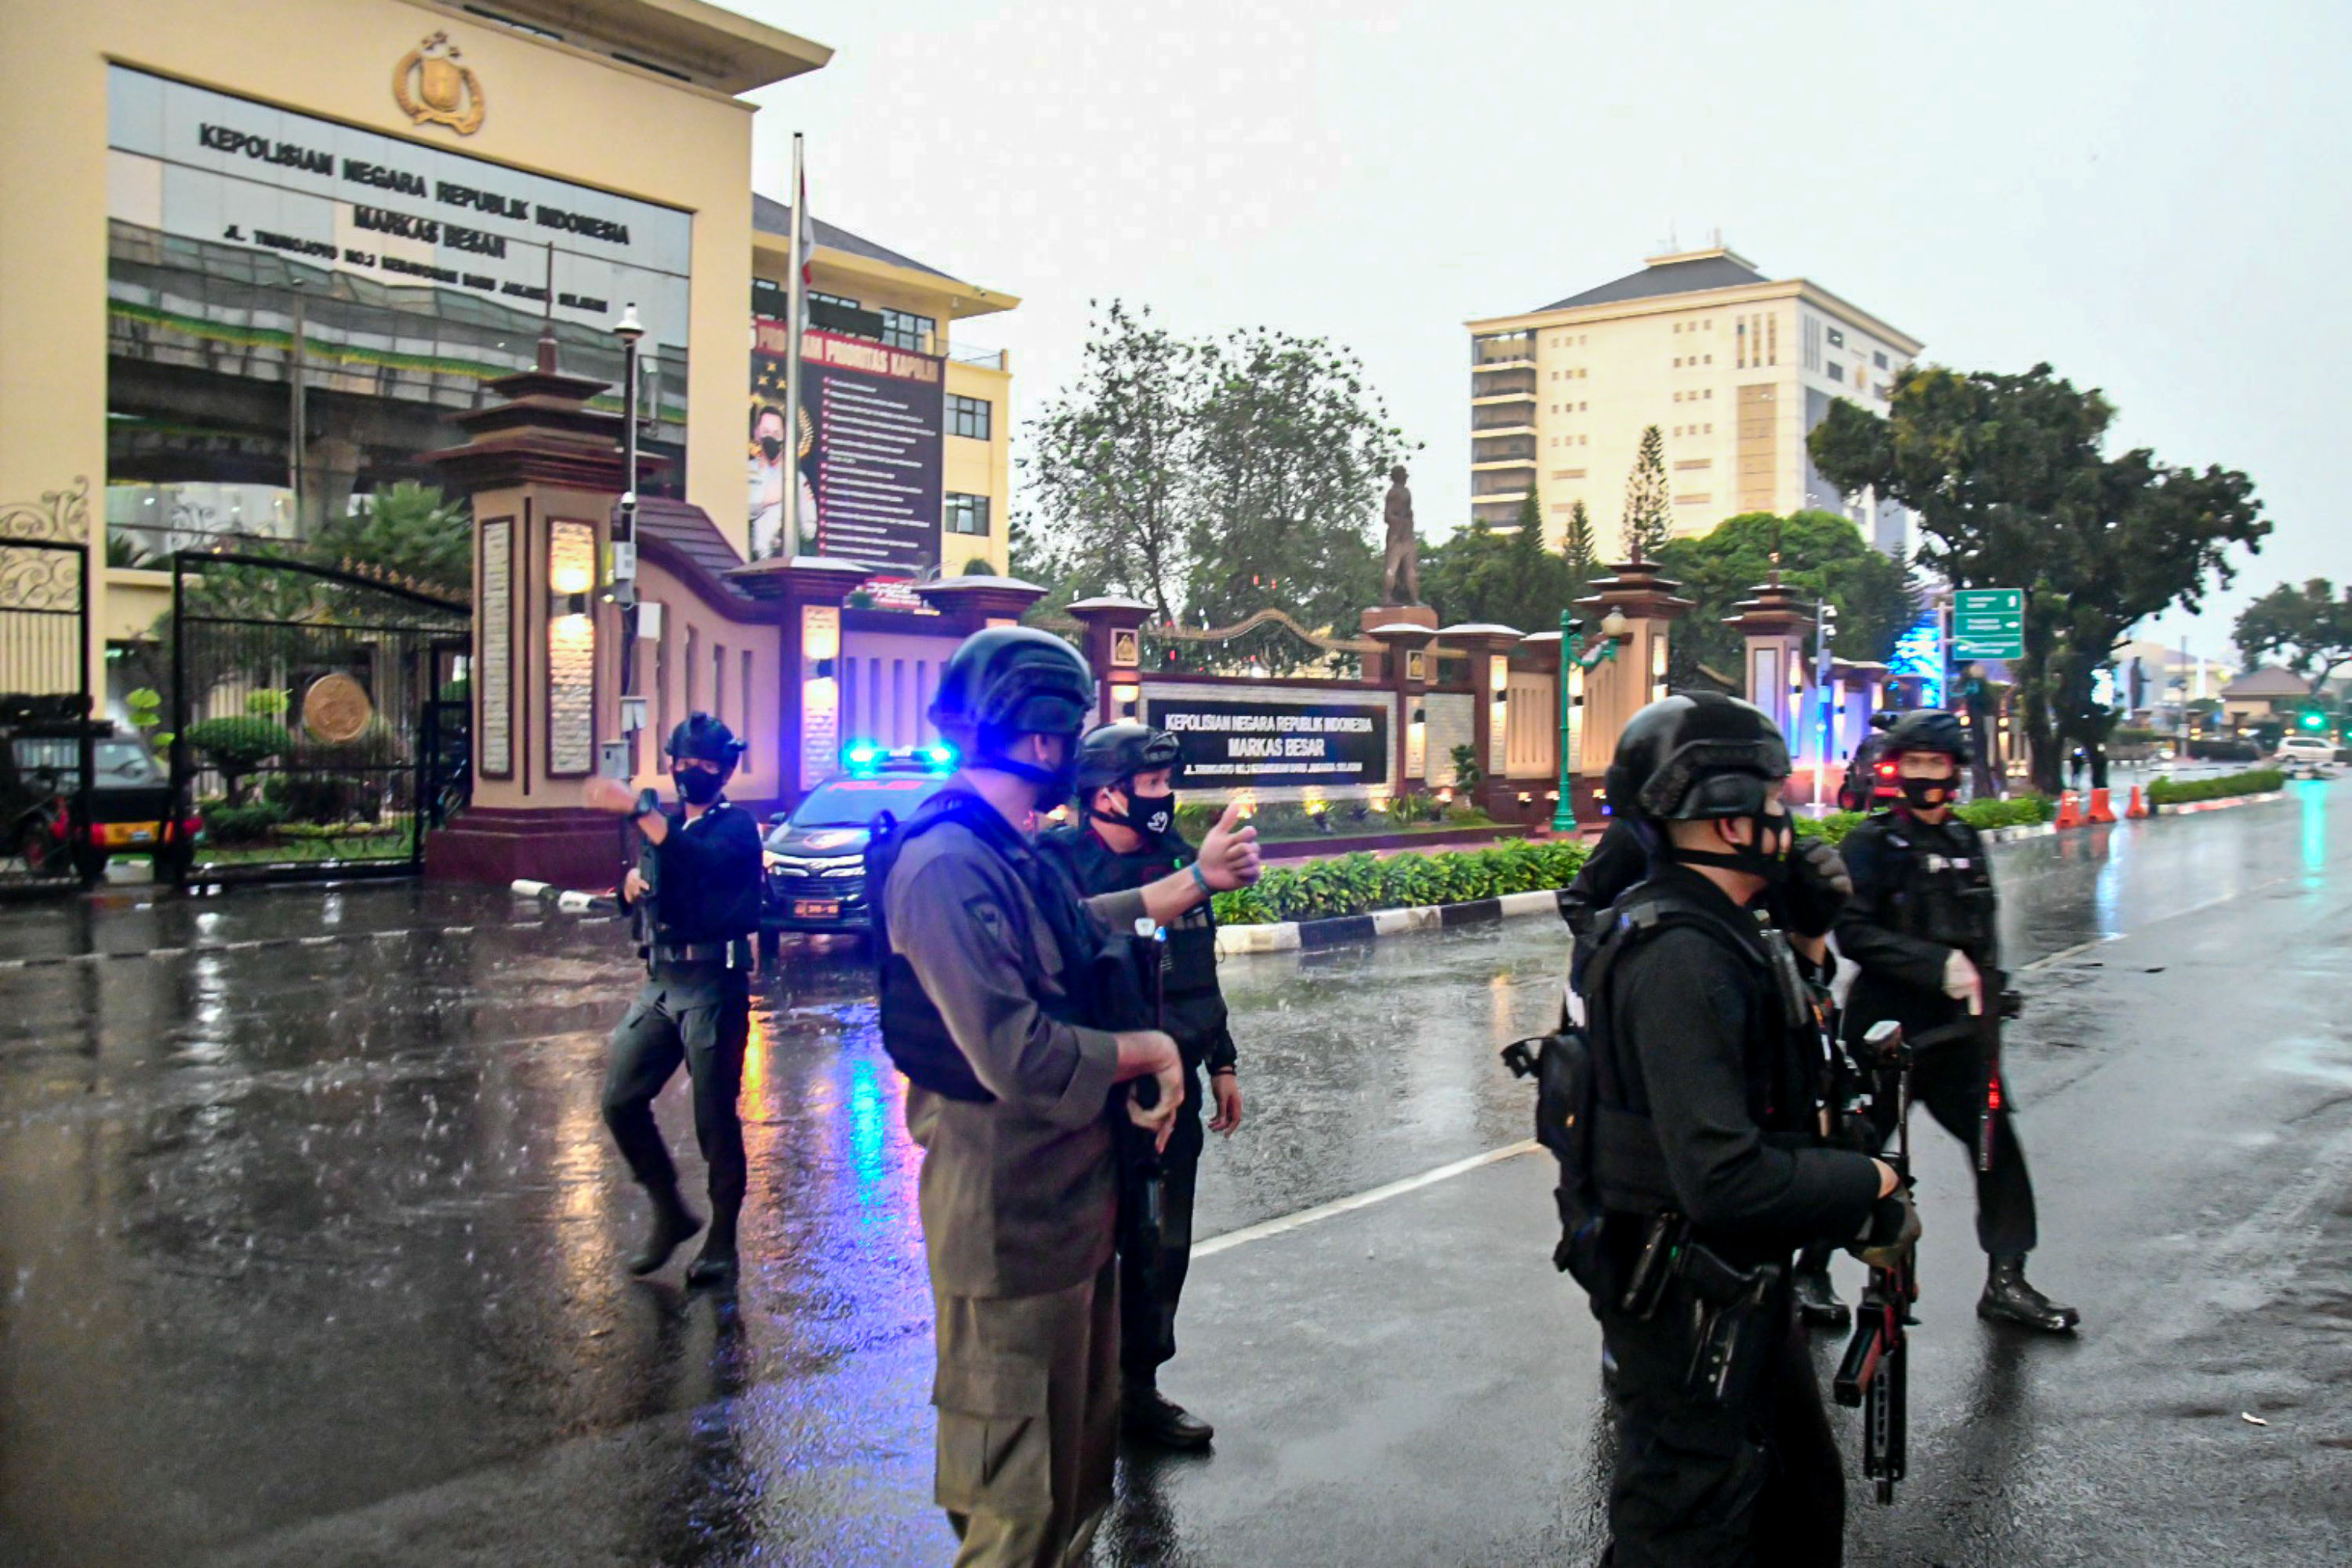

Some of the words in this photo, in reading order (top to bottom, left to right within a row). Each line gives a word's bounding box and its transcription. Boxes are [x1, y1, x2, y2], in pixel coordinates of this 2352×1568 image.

[200, 123, 334, 176] KEPOLISIAN
[343, 158, 427, 198] NEGARA
[437, 181, 529, 220] REPUBLIK
[536, 205, 630, 245] INDONESIA
[354, 205, 438, 244] MARKAS
[443, 225, 506, 260] BESAR
[1165, 714, 1231, 731] KEPOLISIAN
[1231, 715, 1275, 732] NEGARA
[1276, 717, 1323, 732] REPUBLIK
[1323, 717, 1373, 733] INDONESIA
[1228, 738, 1283, 758] MARKAS
[1284, 739, 1325, 757] BESAR
